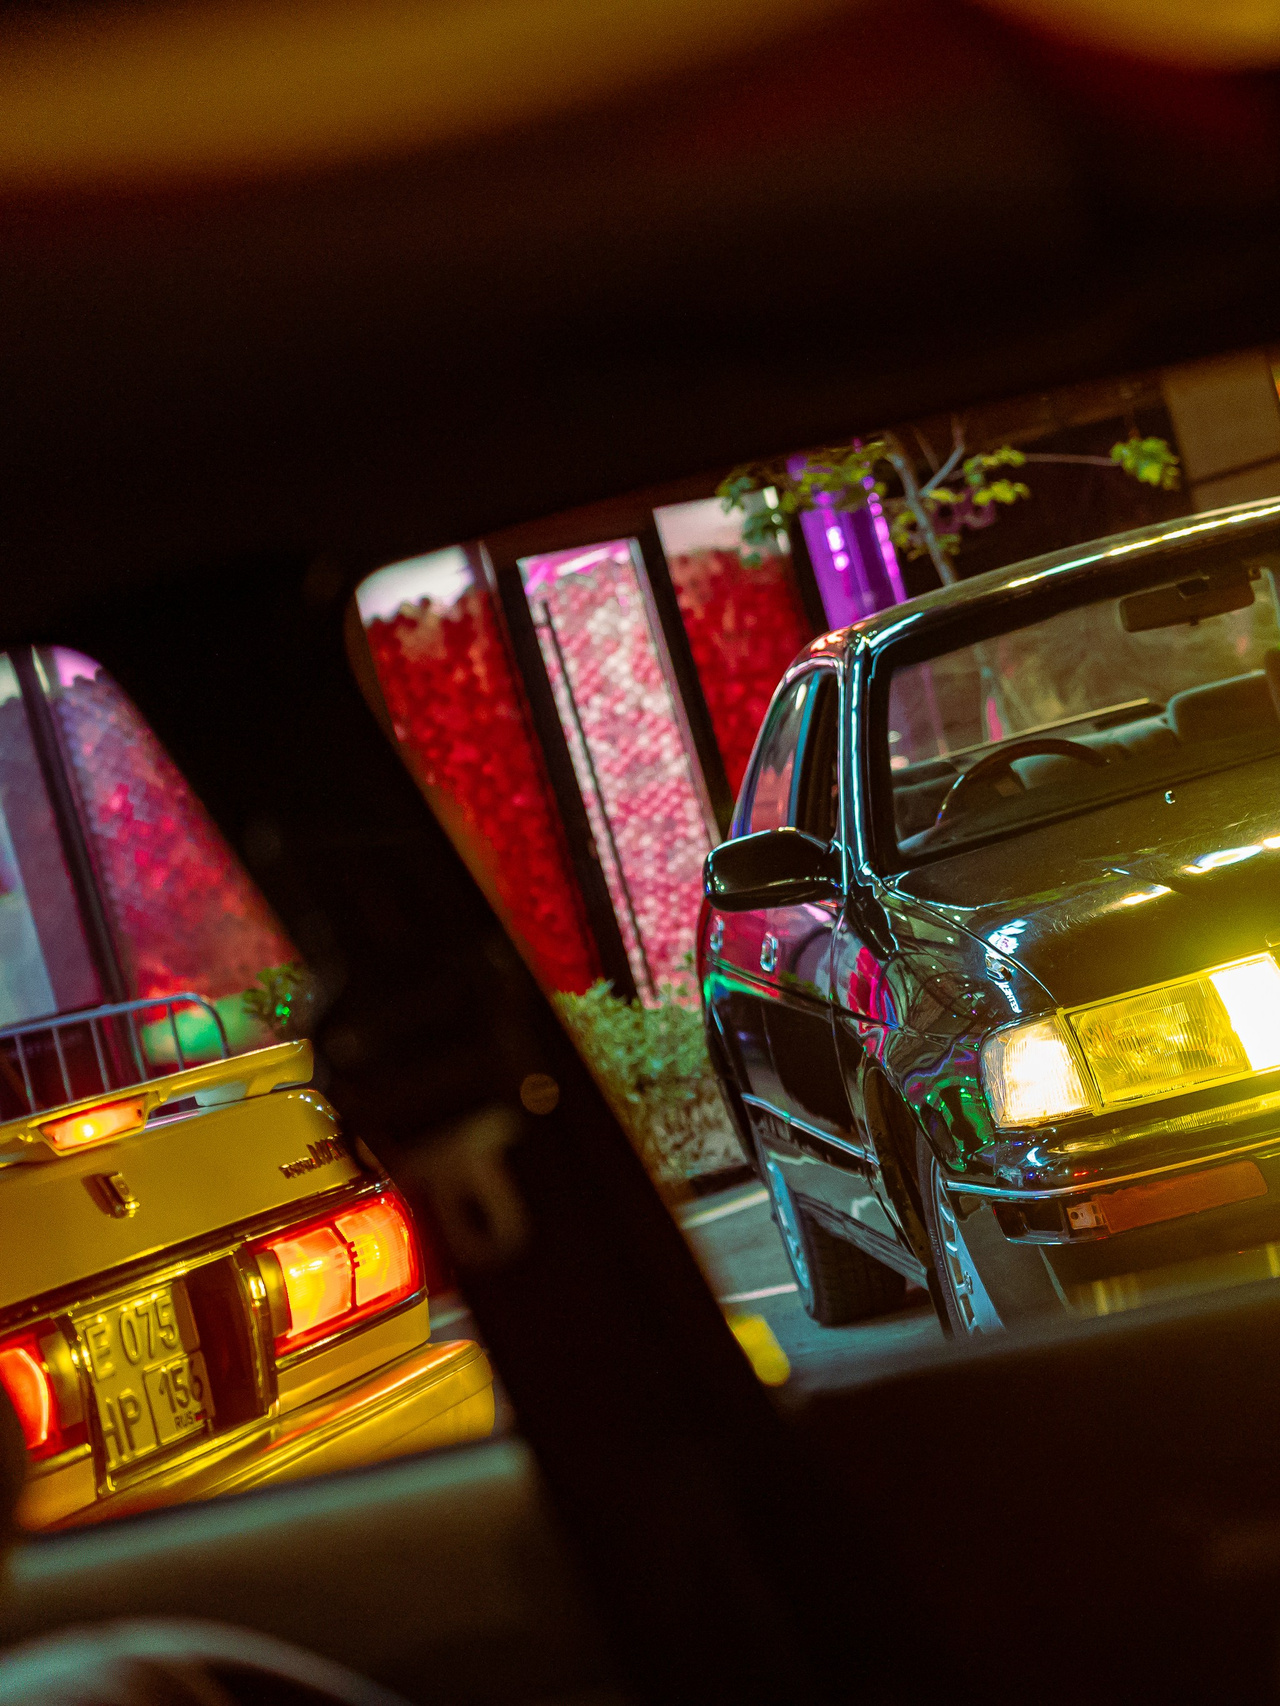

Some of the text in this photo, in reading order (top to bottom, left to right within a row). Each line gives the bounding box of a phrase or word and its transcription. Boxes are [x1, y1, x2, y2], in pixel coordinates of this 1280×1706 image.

[84, 1293, 180, 1382] Е 075
[158, 1358, 204, 1413] 156
[173, 1411, 195, 1430] RUS
